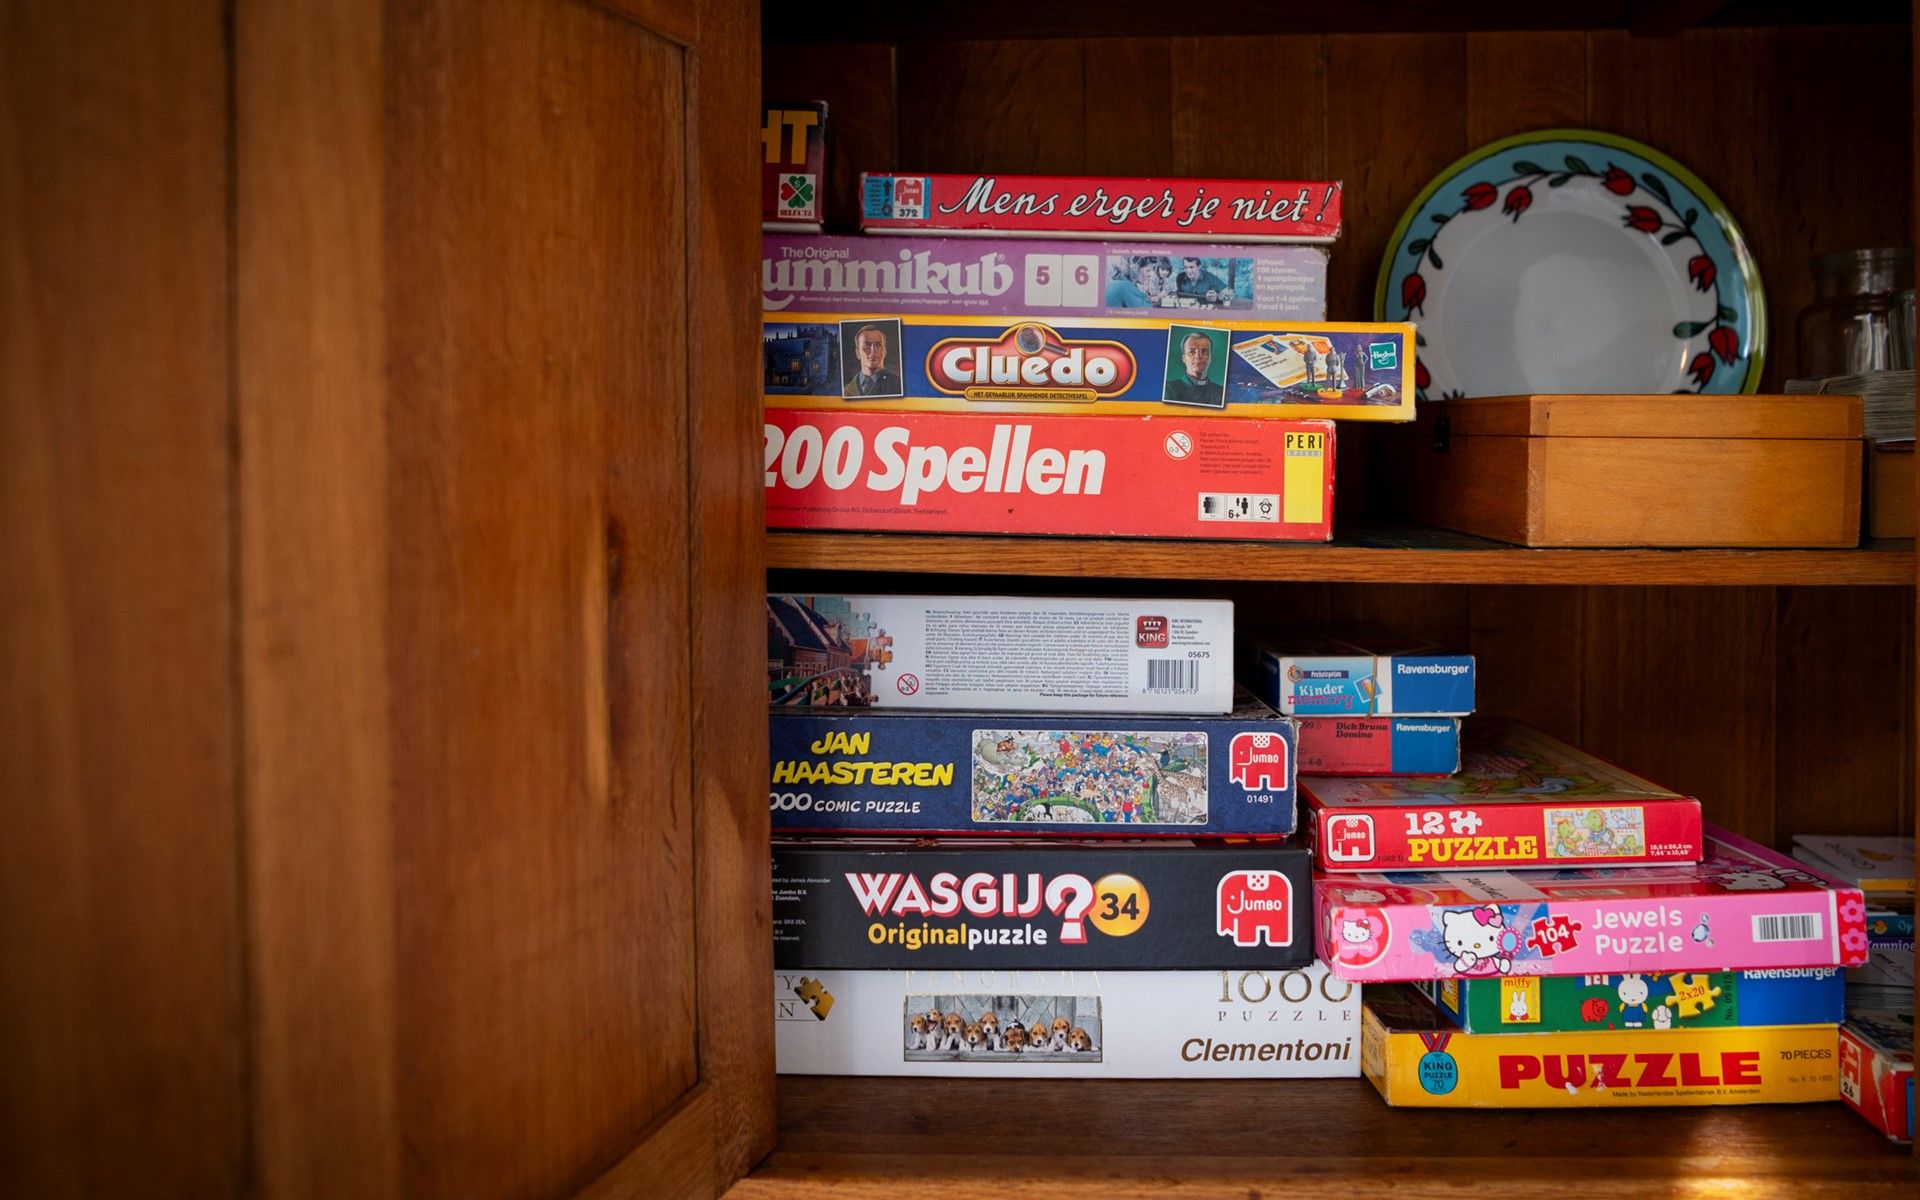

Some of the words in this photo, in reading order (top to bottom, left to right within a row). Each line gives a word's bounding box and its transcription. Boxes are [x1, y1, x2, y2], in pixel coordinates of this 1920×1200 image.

[938, 176, 1058, 215] Mens
[1063, 188, 1175, 225] erger
[1176, 188, 1223, 228] je
[1228, 189, 1309, 222] niet
[780, 209, 812, 217] SELECTA
[899, 208, 918, 218] 372
[780, 246, 802, 259] The
[805, 247, 849, 260] Original
[763, 249, 1014, 297] ummikub
[1035, 265, 1050, 285] 5
[1074, 265, 1089, 285] 6
[942, 346, 1117, 387] Cluedo
[1287, 434, 1322, 449] PERI
[867, 424, 1106, 505] Spellen
[1228, 509, 1240, 519] 6+
[1138, 632, 1166, 643] KING
[1188, 651, 1210, 659] 05675
[1397, 663, 1469, 676] Ravensburger
[1299, 683, 1344, 697] Kinder
[1287, 695, 1353, 709] memory
[1336, 722, 1358, 730] Dick
[1359, 722, 1388, 731] Bruna
[1336, 730, 1373, 738] Domino
[1396, 723, 1450, 734] Ravensburger
[811, 731, 870, 755] JAN
[772, 760, 954, 786] HAASTEREN
[1246, 794, 1273, 803] 01491
[814, 800, 861, 812] COMIC
[865, 801, 921, 814] PUZZLE
[1404, 811, 1446, 835] 12
[1407, 836, 1538, 862] PUZZLE
[1100, 893, 1140, 921] 34
[1592, 905, 1682, 930] Jewels
[868, 923, 1047, 950] Originalpuzzle
[1537, 924, 1569, 944] 104
[1594, 931, 1684, 955] Puzzle
[1744, 967, 1838, 980] Ravensburger
[1218, 970, 1353, 1003] 1000
[1503, 977, 1531, 988] miffy
[1679, 985, 1705, 1001] 2x20
[1218, 1010, 1352, 1021] PUZZLE
[1181, 1036, 1352, 1062] Clementoni
[1780, 1050, 1792, 1060] 70
[1793, 1049, 1831, 1060] PIECES
[1424, 1062, 1453, 1071] KING
[1498, 1051, 1762, 1089] PUZZLE
[1433, 1079, 1444, 1088] 70
[1843, 1081, 1854, 1098] 26
